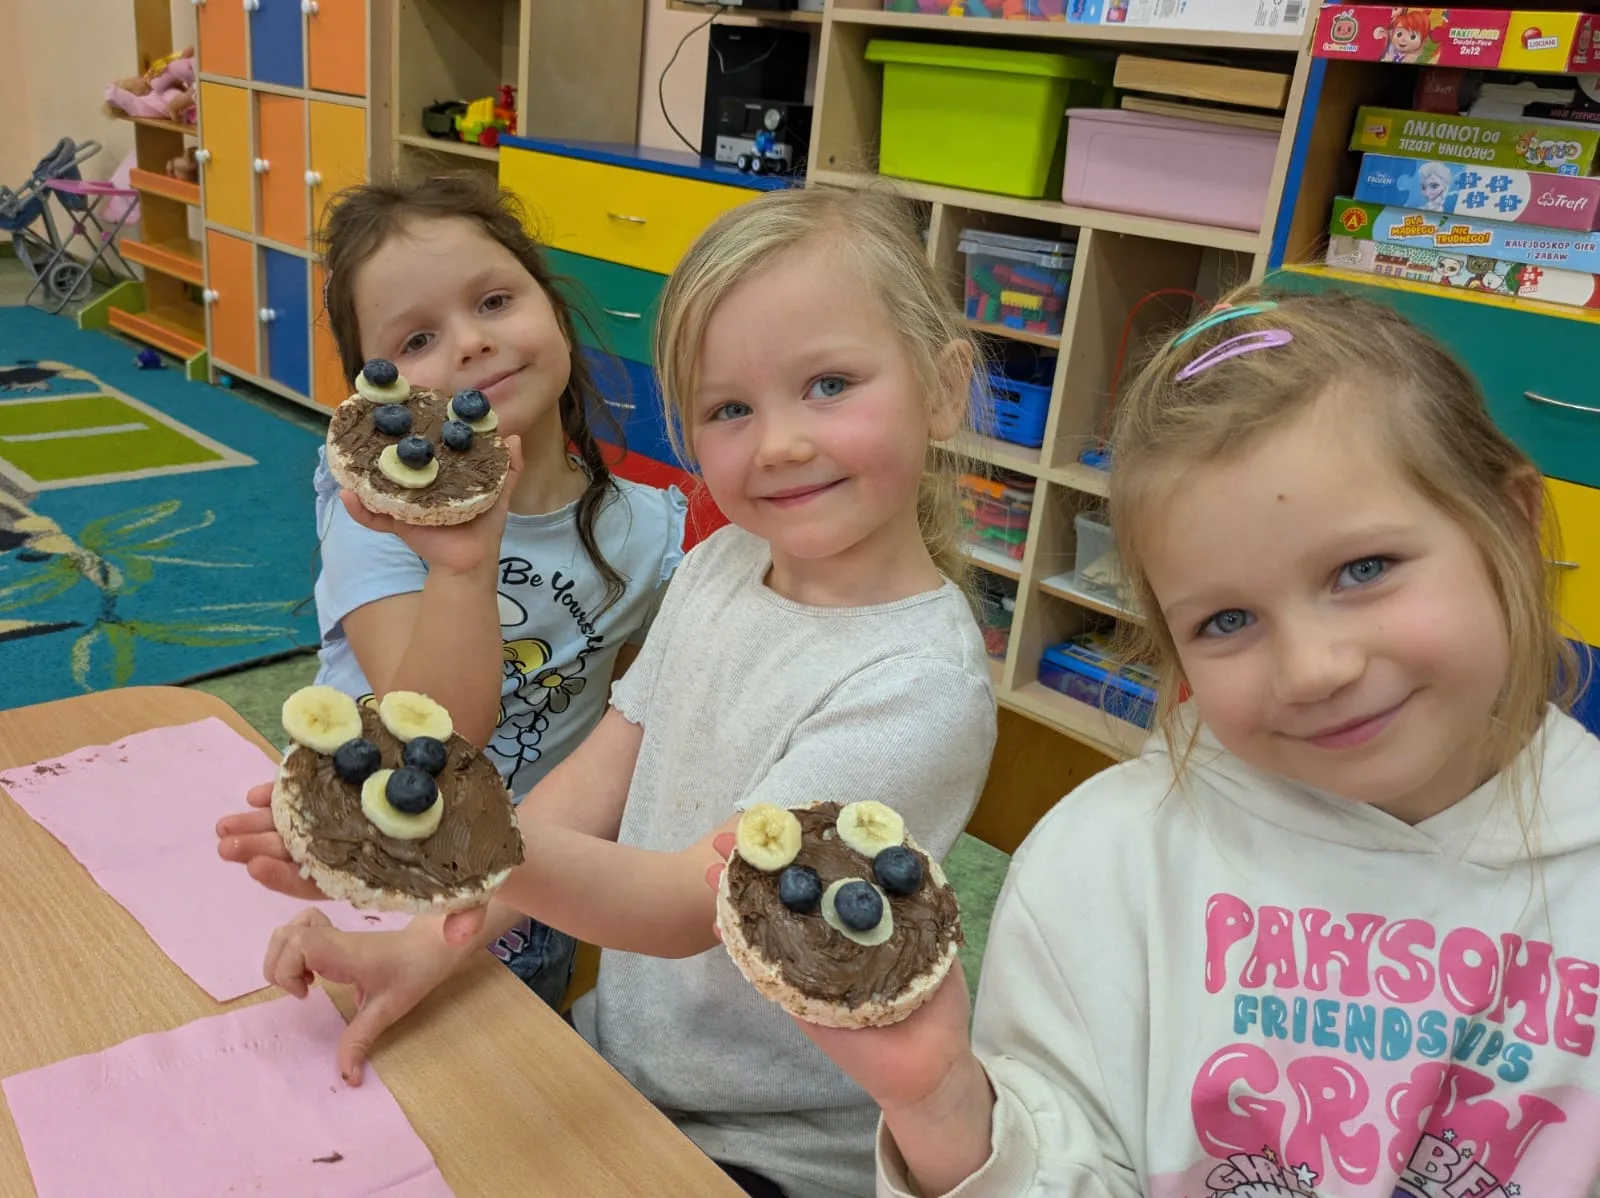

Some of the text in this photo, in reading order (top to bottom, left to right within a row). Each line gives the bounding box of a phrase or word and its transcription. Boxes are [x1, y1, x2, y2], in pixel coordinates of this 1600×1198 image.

[1460, 46, 1480, 56] 2x12
[1403, 119, 1500, 143] DO LONDYNU
[1399, 138, 1497, 161] CAROTINA JEDZIE
[1404, 215, 1424, 226] DLA
[1451, 226, 1469, 235] NIC
[1436, 232, 1491, 244] TRUDNEGO!
[1504, 240, 1596, 251] KALEJDOSKOP GIER
[1535, 252, 1568, 260] ZABAW
[1523, 272, 1535, 281] 24
[499, 557, 544, 588] Be
[1205, 892, 1599, 1057] PAWSOME
